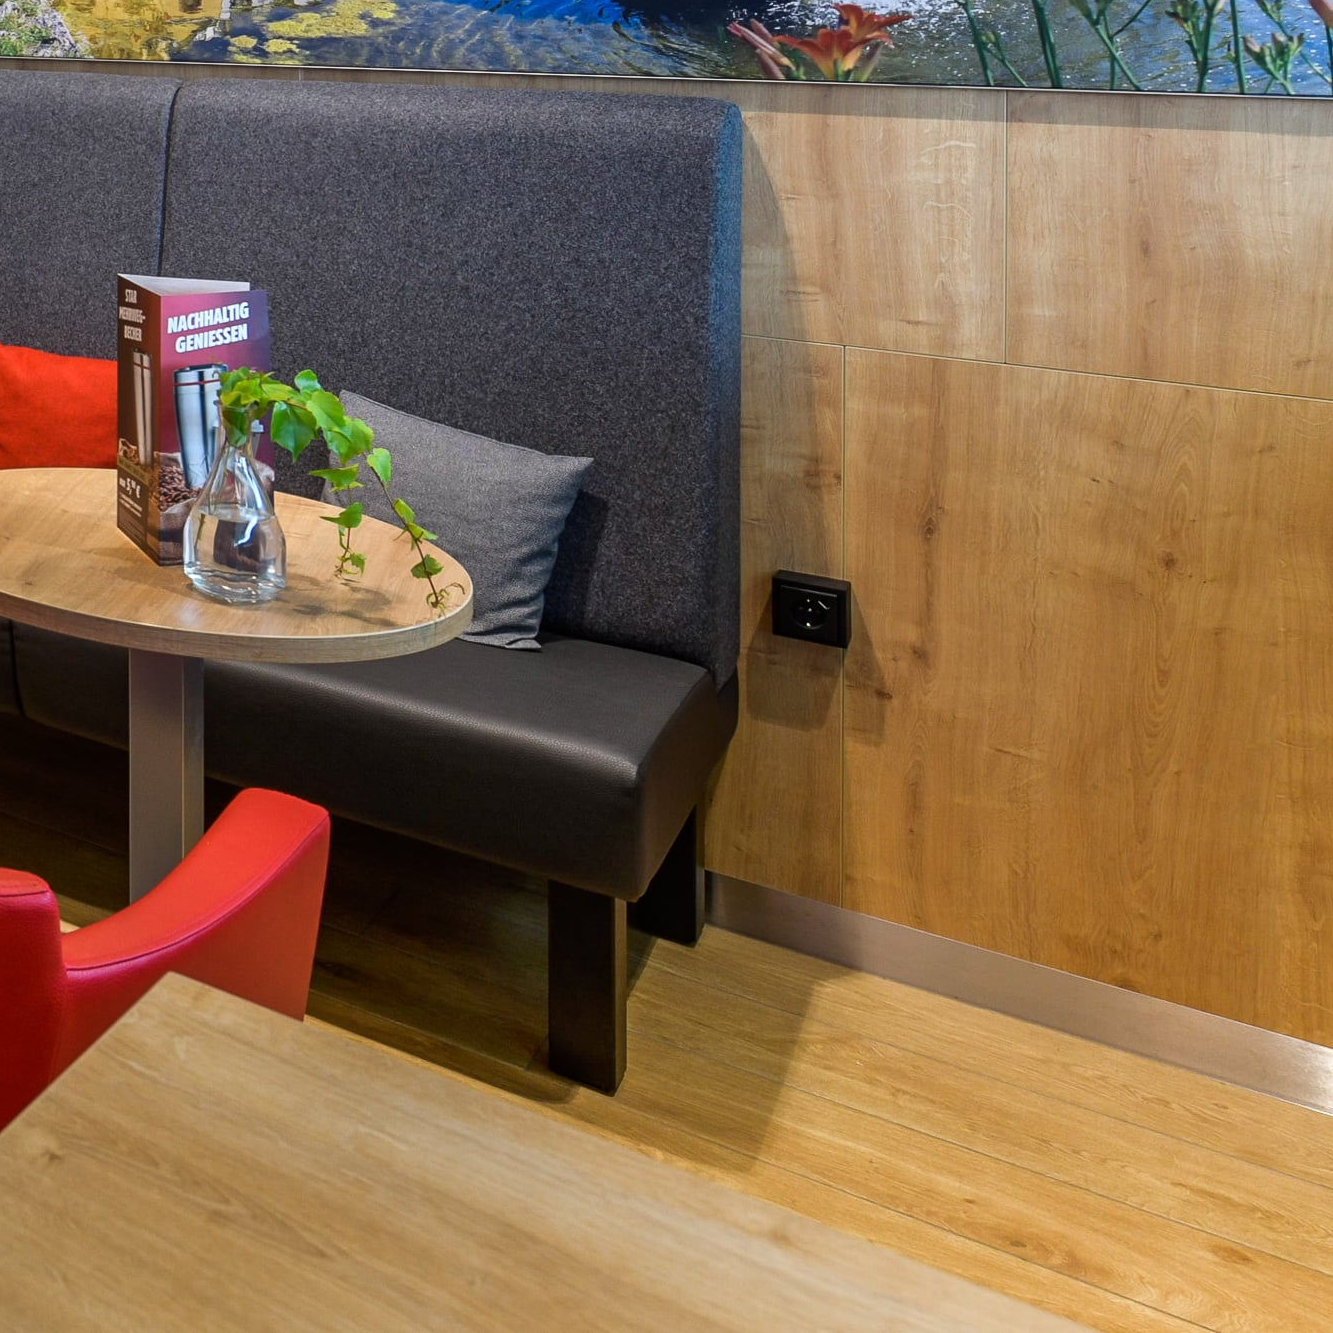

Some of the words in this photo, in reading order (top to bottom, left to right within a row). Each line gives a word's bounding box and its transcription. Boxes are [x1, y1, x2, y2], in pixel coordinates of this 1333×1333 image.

[125, 288, 137, 303] STAR
[119, 306, 146, 323] MEHRWEG-
[167, 302, 250, 334] NACHHALTIG
[124, 325, 142, 342] BECHER
[175, 323, 248, 353] GENIESSEN
